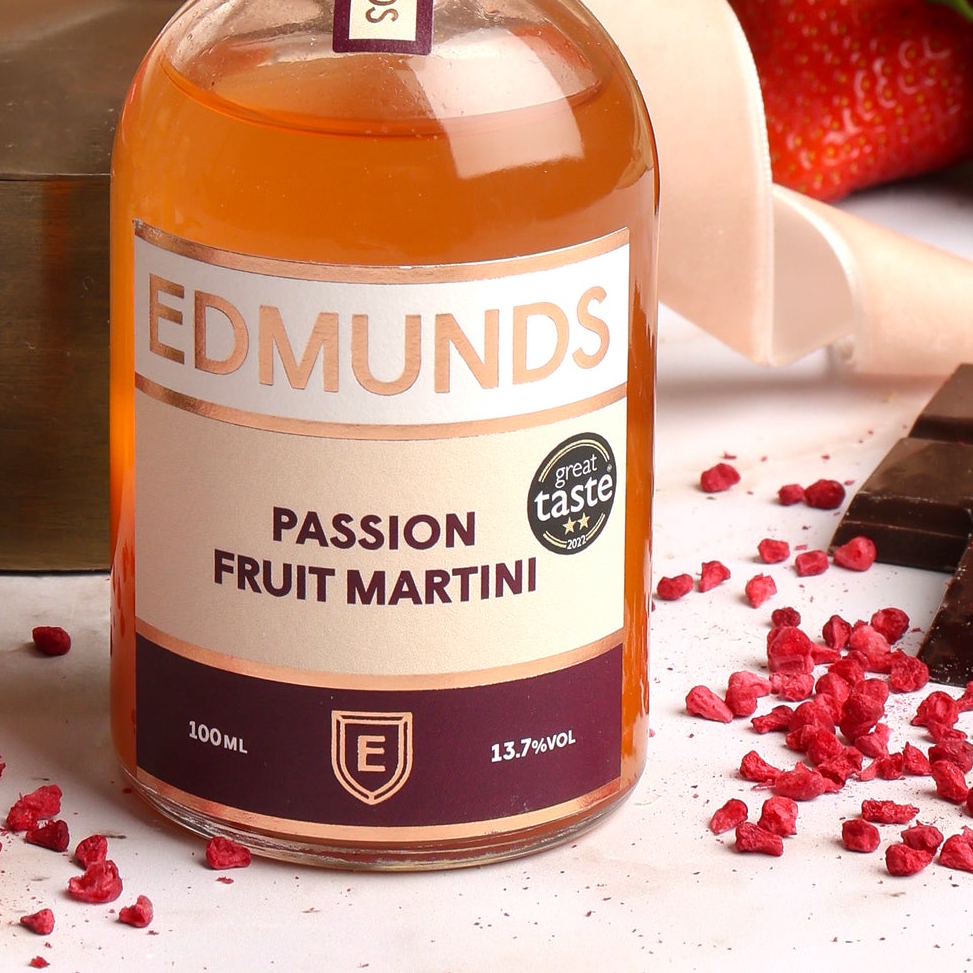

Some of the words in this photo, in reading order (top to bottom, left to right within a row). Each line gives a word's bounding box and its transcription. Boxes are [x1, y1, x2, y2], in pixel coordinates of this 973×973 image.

[149, 272, 610, 396] EDMUNDS
[555, 453, 597, 488] great
[534, 474, 613, 521] taste
[272, 507, 476, 550] PASSION
[567, 534, 587, 549] 2022
[214, 549, 335, 602] FRUIT
[346, 557, 537, 605] MARTINI
[357, 735, 385, 772] E
